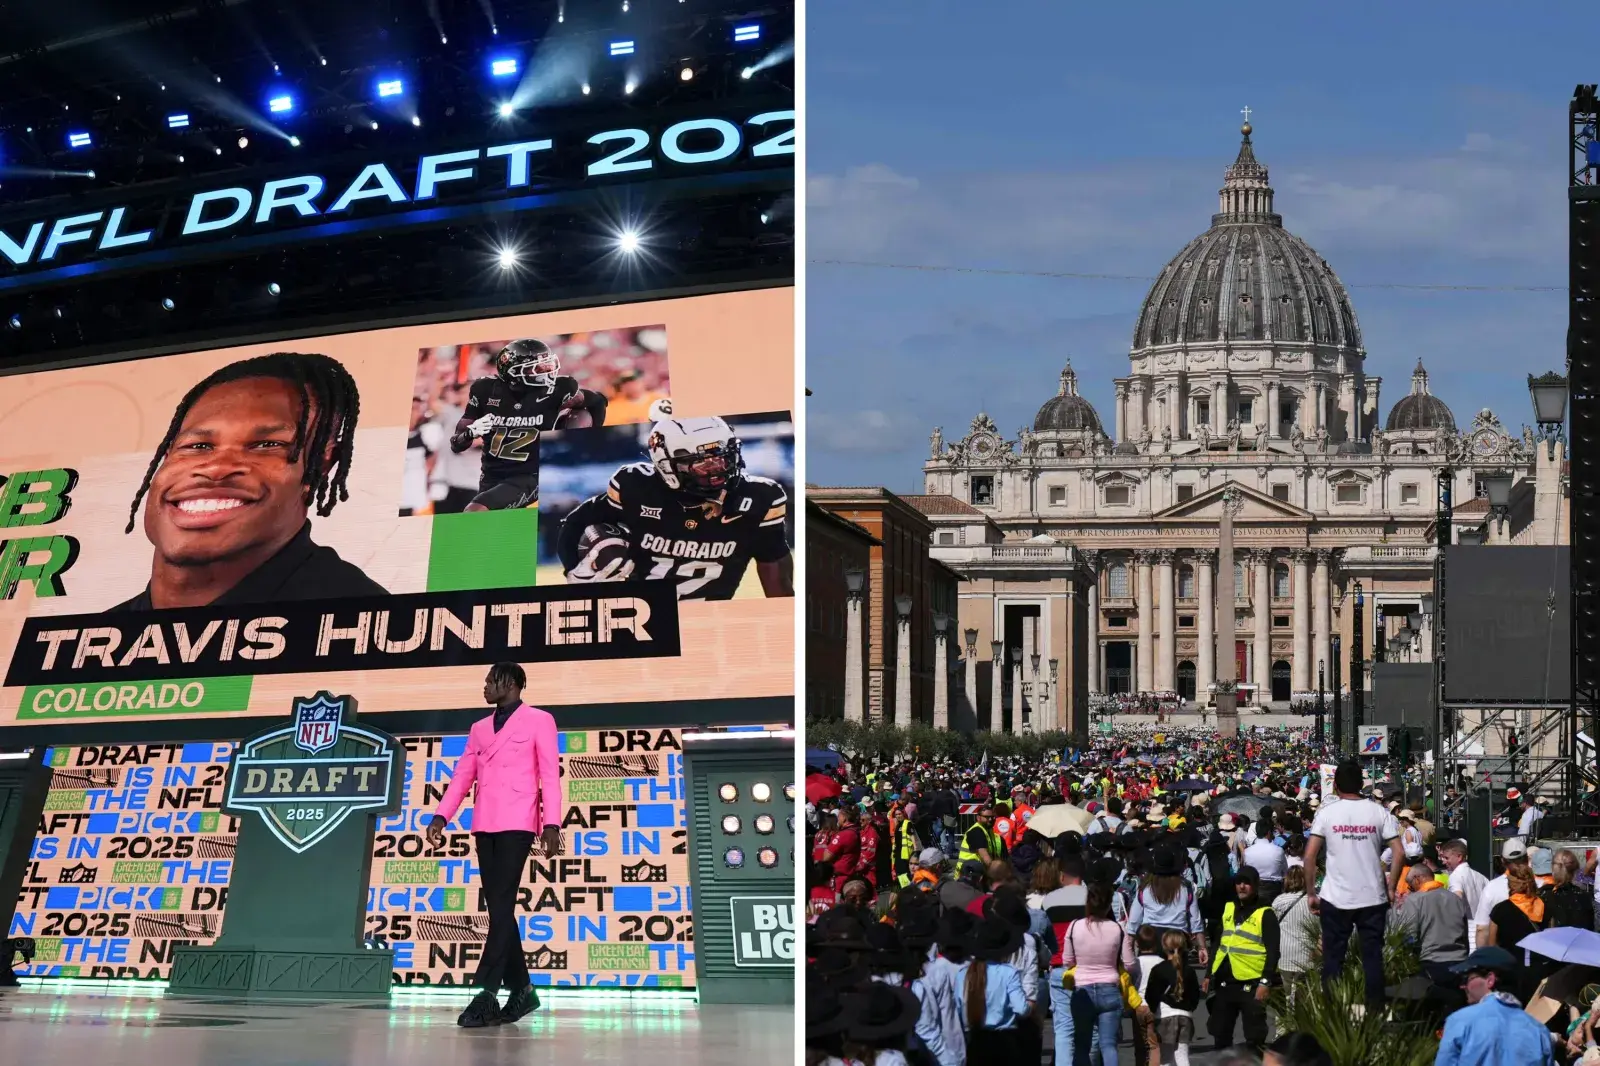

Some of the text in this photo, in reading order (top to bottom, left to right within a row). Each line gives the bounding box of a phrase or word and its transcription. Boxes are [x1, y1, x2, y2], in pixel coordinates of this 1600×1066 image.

[0, 208, 154, 264] NFL
[181, 138, 554, 236] DRAFT
[490, 414, 544, 427] COLORADO
[489, 427, 540, 462] 12
[640, 533, 737, 559] COLORADO
[36, 596, 654, 671] TRAVIS HUNTER
[32, 681, 205, 714] COLORADO
[300, 722, 333, 746] NFL
[76, 744, 184, 766] DRAFT
[124, 767, 154, 787] IS
[163, 766, 196, 787] IN
[243, 766, 378, 793] DRAFT
[572, 780, 621, 791] GREEN BAY
[87, 788, 222, 810] THE NFL
[570, 791, 624, 801] WISCONSIN
[116, 812, 189, 833] PICK
[286, 808, 324, 820] 2025
[1332, 825, 1377, 834] SARDEGNA
[30, 836, 195, 859] IS IN 2025
[374, 834, 471, 857] 2025
[574, 831, 609, 855] IS
[622, 831, 660, 855] IN
[112, 873, 160, 883] WISCONSIN
[116, 861, 161, 872] GREEN BAY
[163, 861, 231, 884] THE
[383, 872, 438, 883] WISCONSIN
[387, 861, 437, 872] GREEN BAY
[529, 859, 607, 883] NFL
[77, 887, 151, 910] PICK
[41, 913, 131, 936] 2025
[518, 915, 553, 941] IS
[568, 915, 607, 941] IN
[753, 904, 795, 930] BU
[62, 938, 130, 963] THE
[591, 944, 646, 957] GREEN BAY
[741, 931, 795, 959] LIG
[589, 957, 649, 969] WISCONSIN
